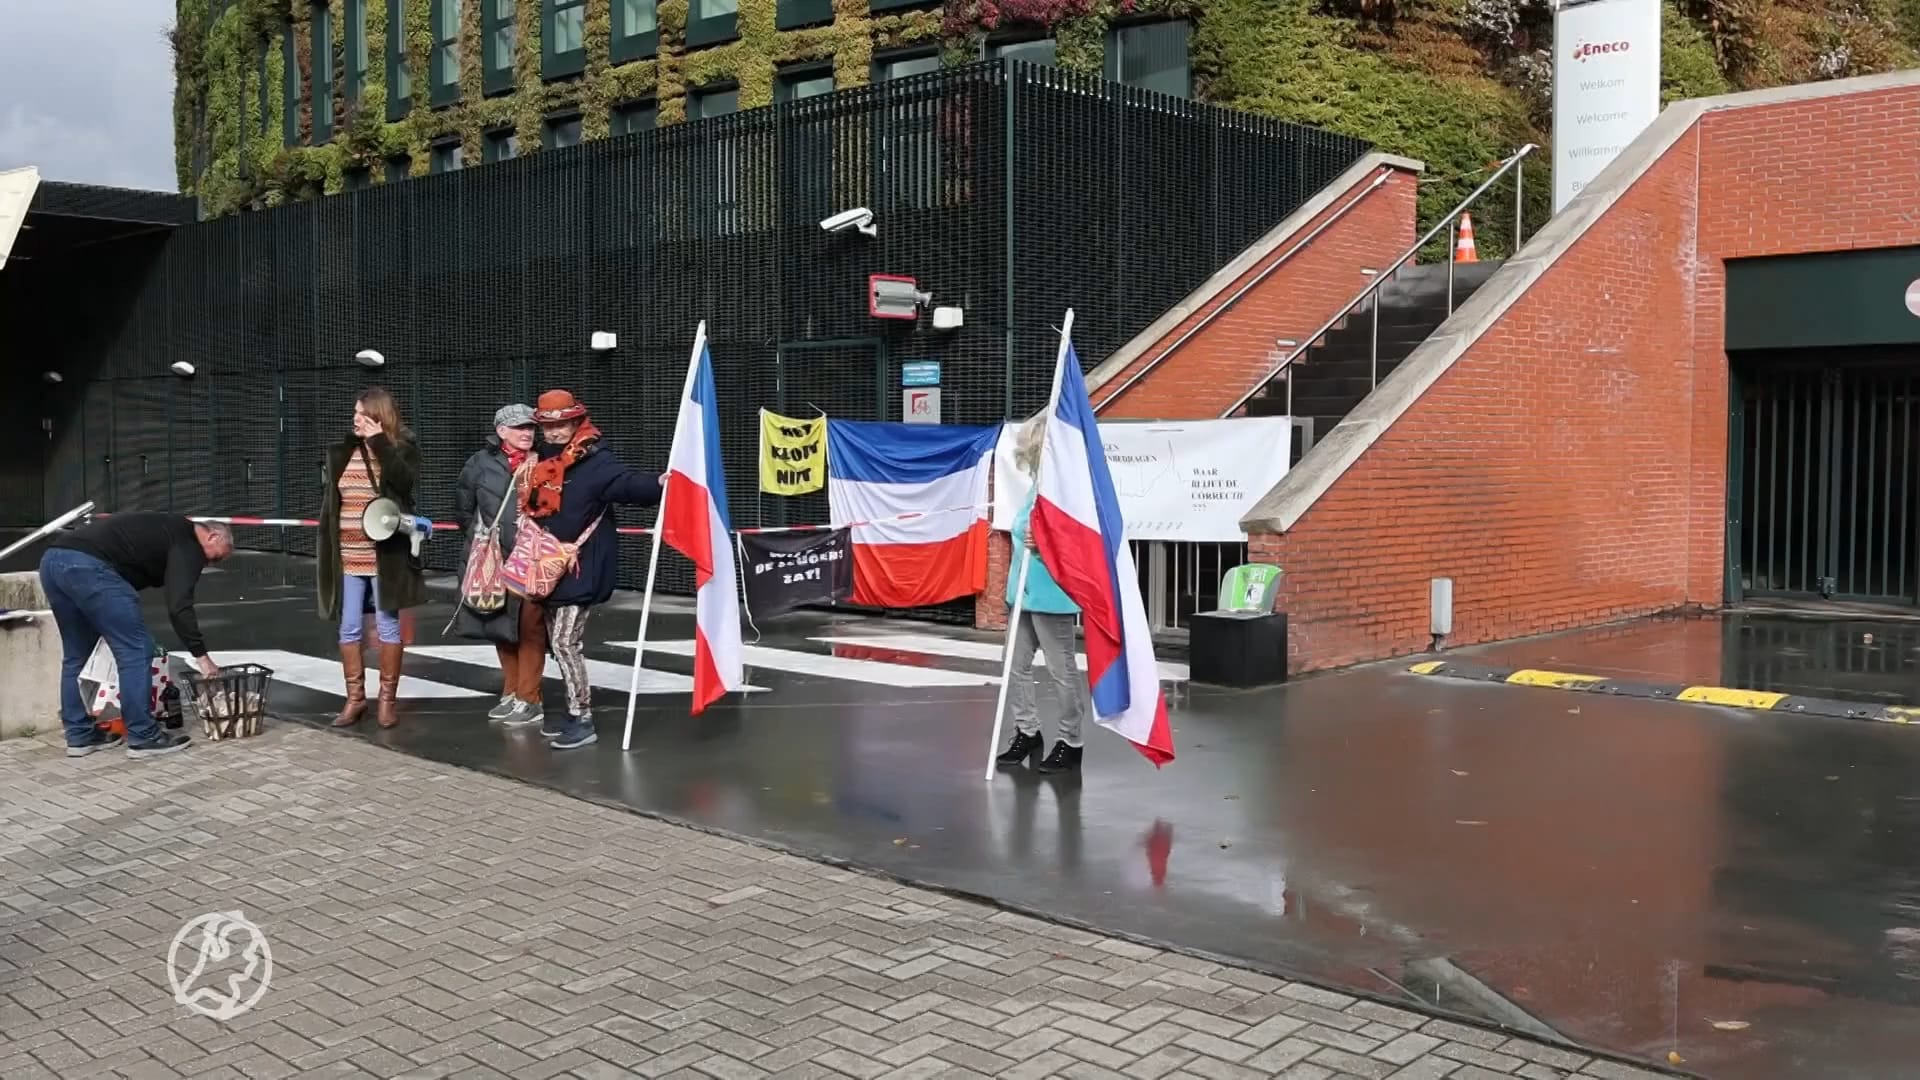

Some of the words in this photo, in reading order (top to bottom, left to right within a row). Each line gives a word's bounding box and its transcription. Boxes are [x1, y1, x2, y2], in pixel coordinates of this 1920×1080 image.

[1583, 40, 1630, 56] Eneco
[1579, 78, 1625, 91] Welkom
[1576, 111, 1628, 125] Welcome
[1568, 145, 1625, 159] Willkomm
[1193, 467, 1219, 476] WAAR
[1225, 479, 1239, 488] DE
